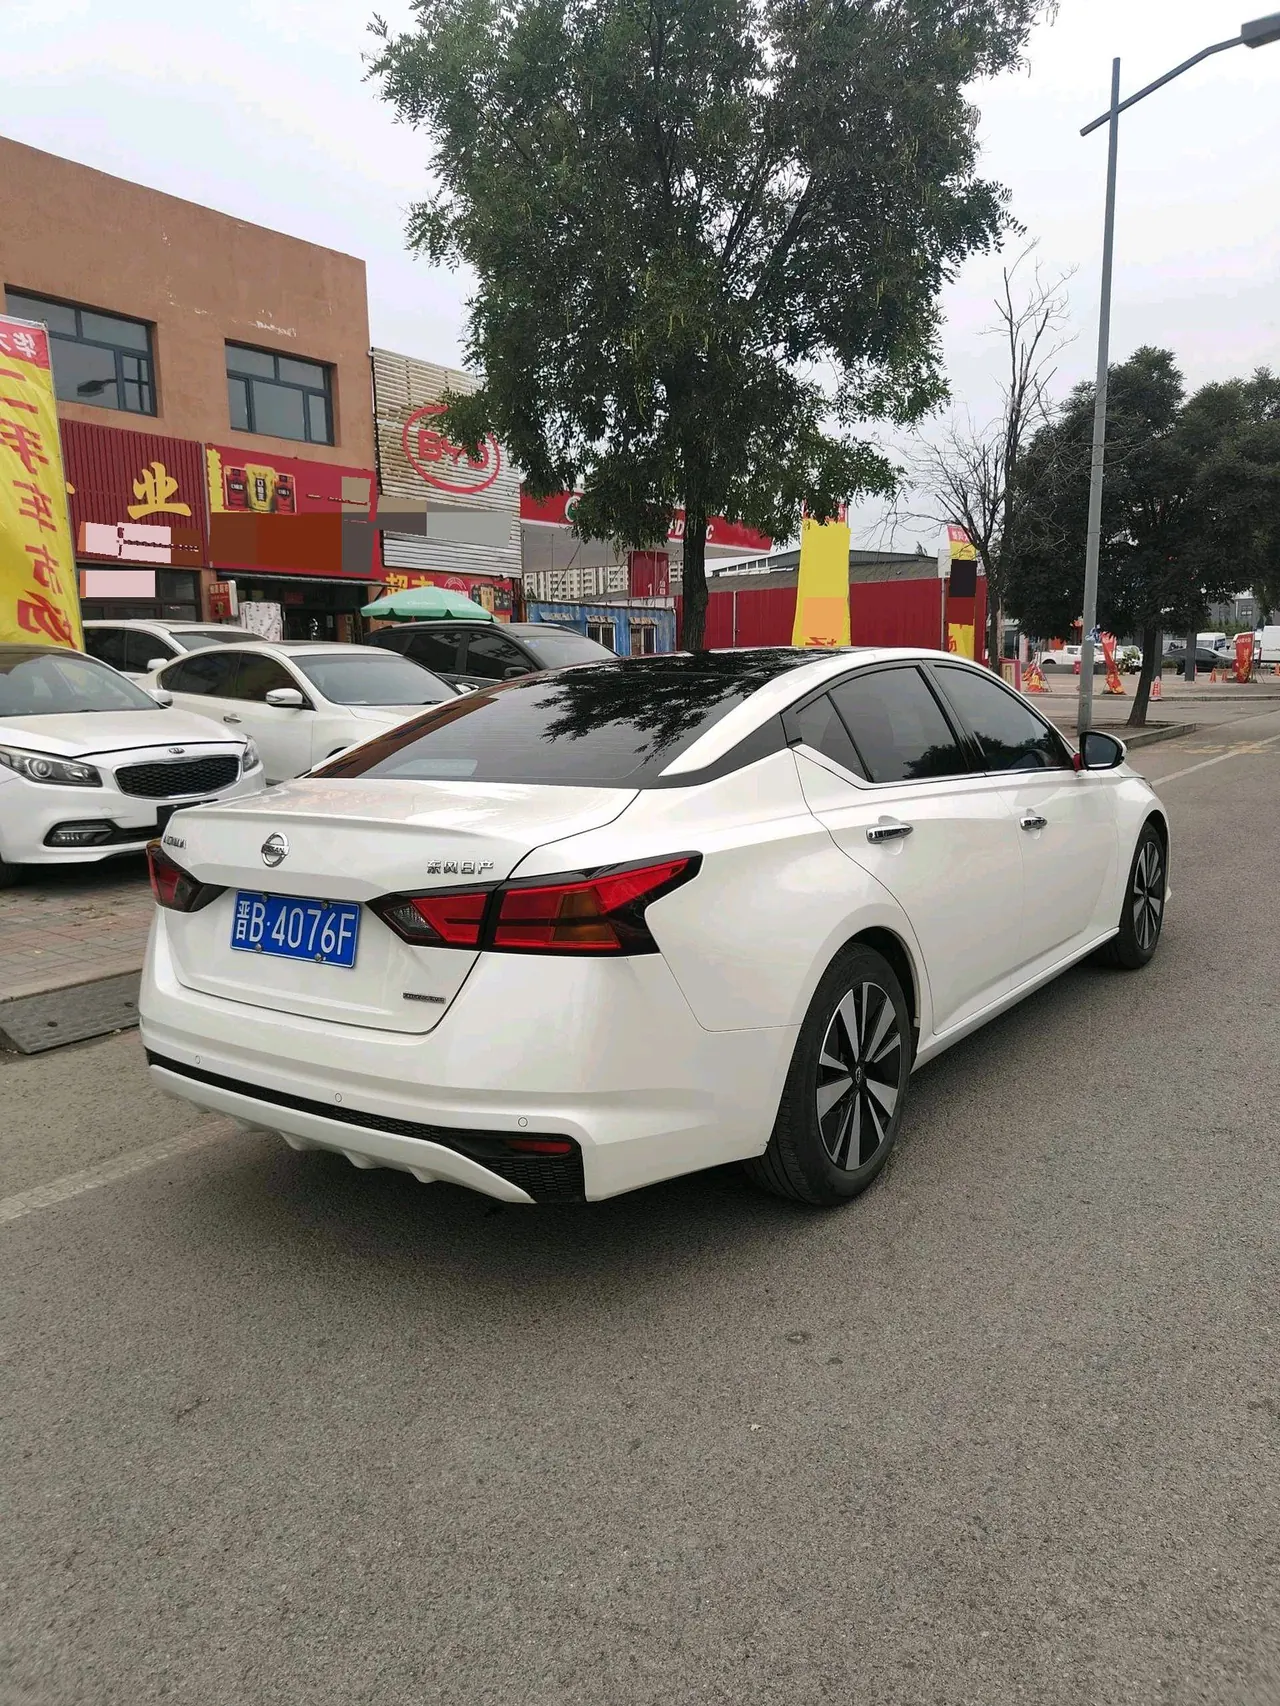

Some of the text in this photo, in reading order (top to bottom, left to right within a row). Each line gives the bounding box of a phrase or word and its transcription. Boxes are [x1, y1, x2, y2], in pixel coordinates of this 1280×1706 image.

[418, 429, 489, 469] BYD
[127, 461, 192, 520] 业
[427, 860, 494, 875] 东风日产
[236, 900, 355, 955] 晋B·4076F
